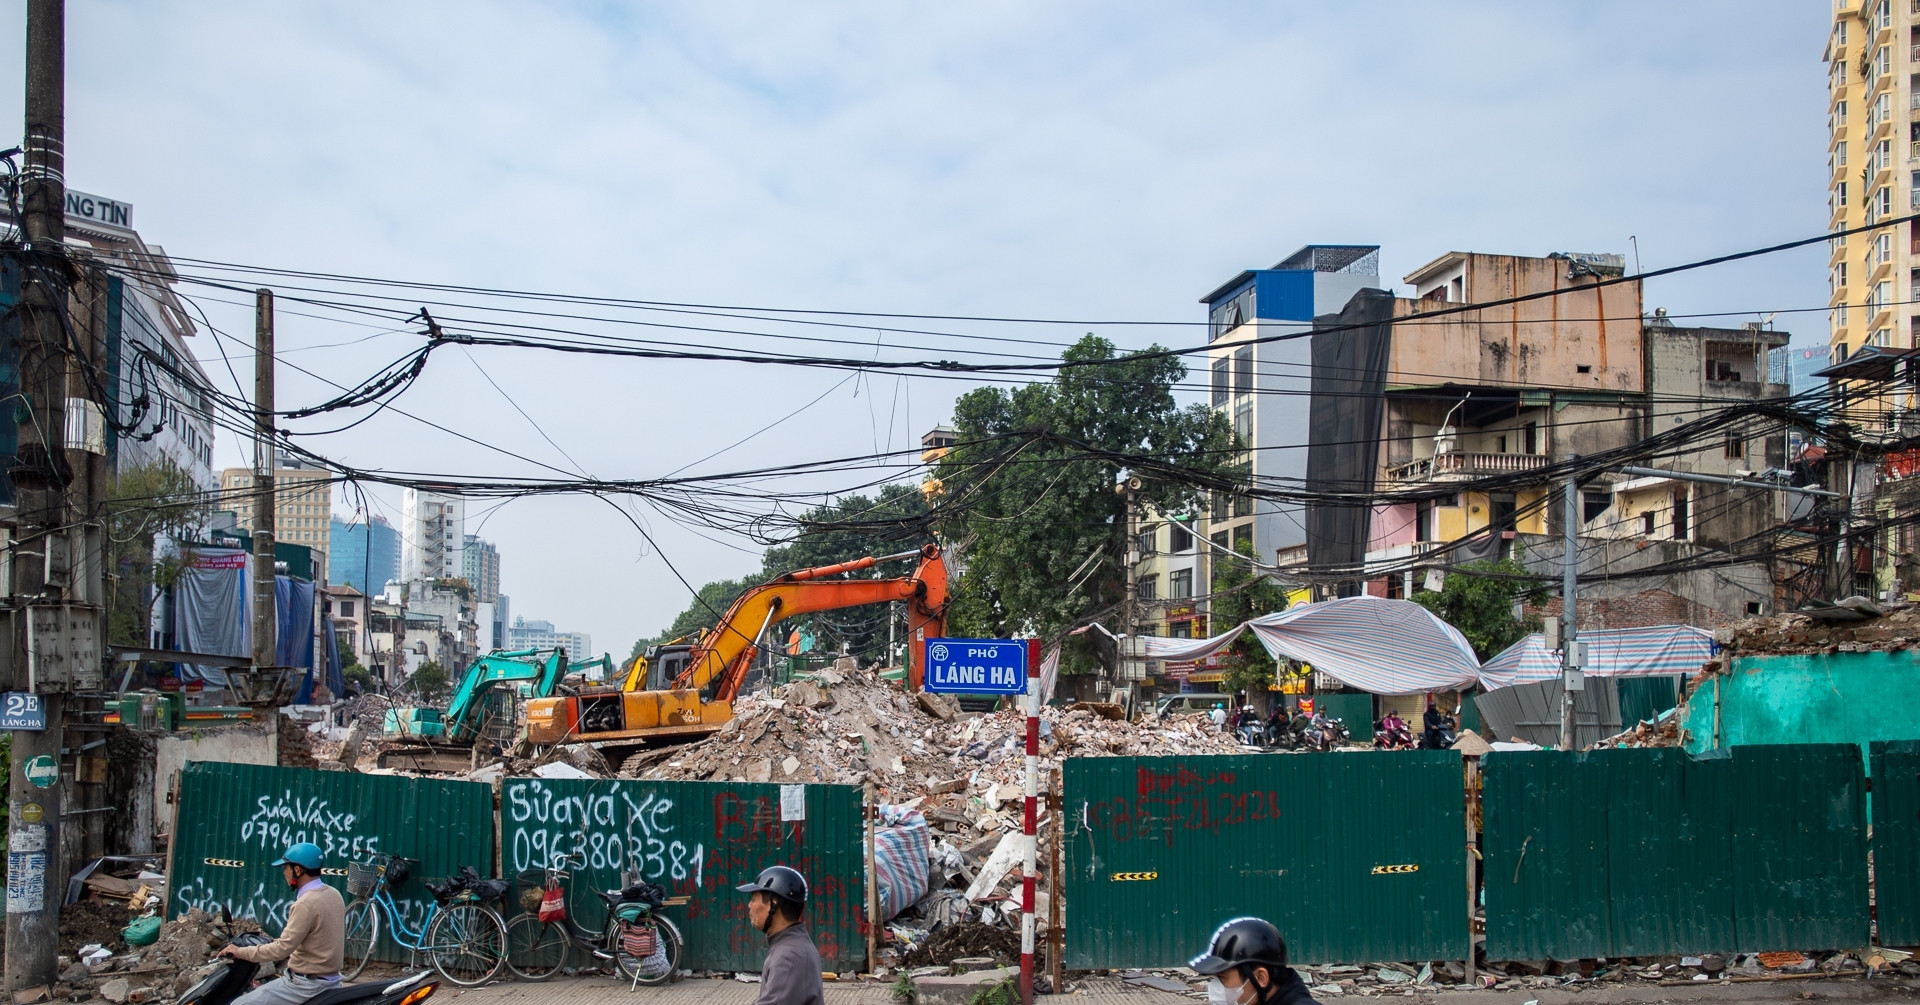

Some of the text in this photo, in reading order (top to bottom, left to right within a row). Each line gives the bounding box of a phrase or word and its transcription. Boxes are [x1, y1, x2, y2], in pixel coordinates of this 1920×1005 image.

[968, 646, 998, 658] PHỐ
[935, 662, 1016, 688] LÁNG HẠ
[6, 695, 38, 716] 2E
[2, 718, 42, 728] LÁNG HẠ
